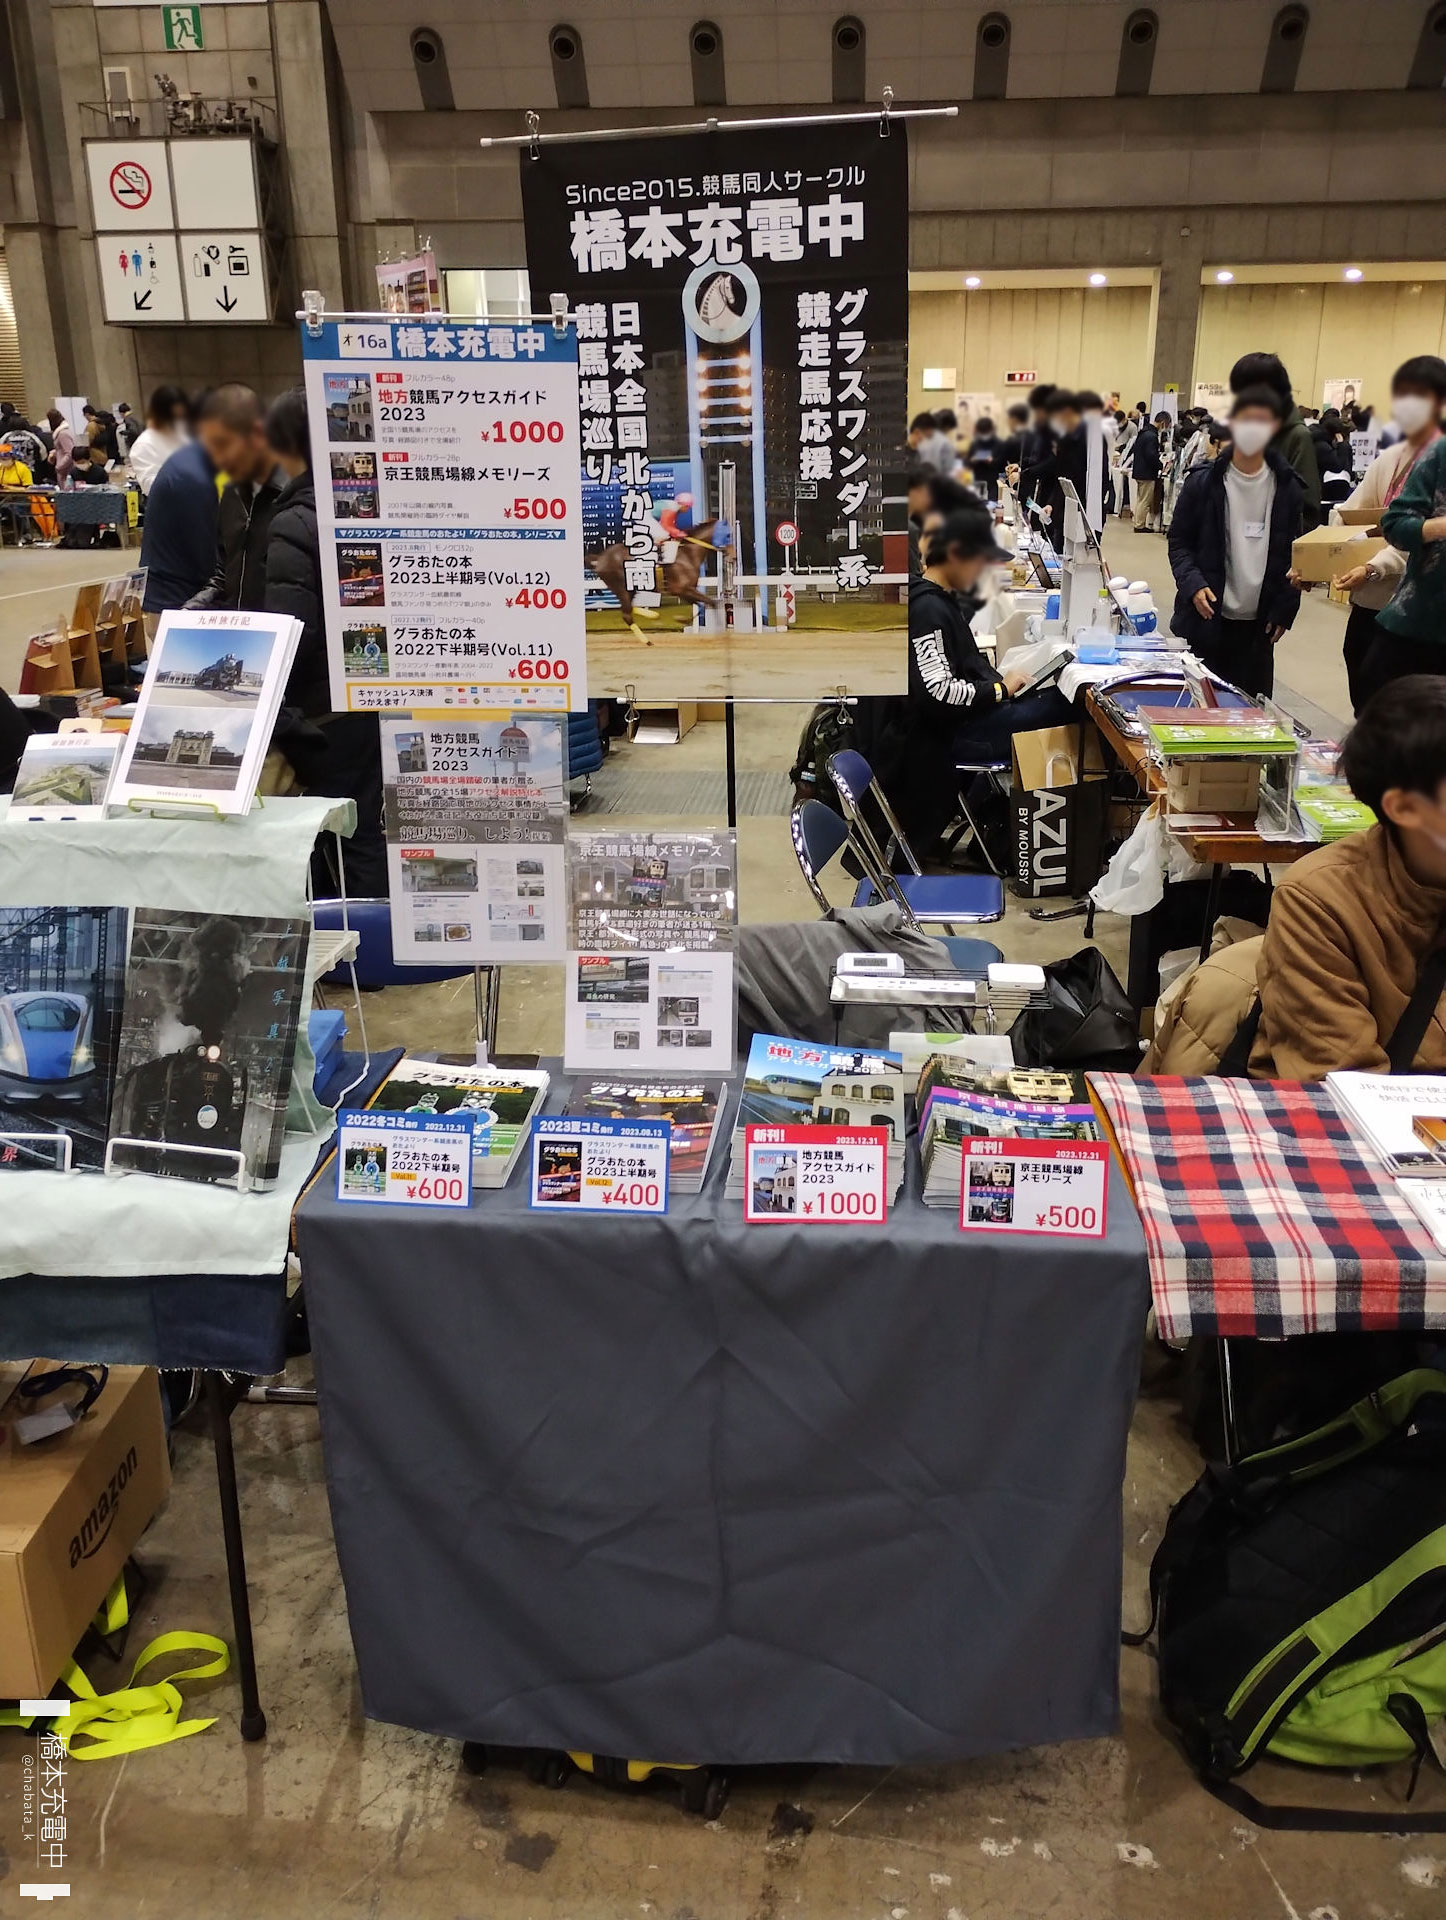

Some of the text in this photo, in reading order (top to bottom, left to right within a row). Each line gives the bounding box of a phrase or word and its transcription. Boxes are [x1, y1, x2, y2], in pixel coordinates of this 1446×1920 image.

[566, 166, 866, 204] Since2015.競馬同人サークル
[570, 194, 864, 272] 橋本充電中
[397, 327, 545, 359] 橋本充電中
[575, 303, 615, 486] 競馬場巡り
[797, 293, 834, 482] 競走馬応援
[378, 389, 547, 405] 地方競馬アクセスガイド
[380, 407, 426, 421] 2023
[480, 420, 564, 443] ¥1000
[835, 288, 872, 588] グラスワンダー系
[612, 302, 660, 591] 日本全国北から南
[384, 466, 550, 482] 京王競馬場線メモリーズ
[503, 498, 567, 520] ¥500
[780, 529, 794, 539] 1200
[389, 555, 473, 568] グラおたの本
[390, 571, 550, 585] 2023上半期号(Vol.12)
[505, 588, 566, 609] ¥400
[198, 615, 251, 626] 九州旅行記
[394, 628, 476, 640] グラおたの本
[395, 643, 553, 657] 2022下半期号(Vol.11)
[508, 660, 569, 680] ¥600
[358, 689, 434, 697] キャッシュレス決済
[431, 733, 480, 745] 地方競馬
[432, 747, 517, 758] アクセスガイド
[432, 760, 469, 771] 2023
[1018, 808, 1028, 885] BY MOUSSY
[1033, 791, 1067, 896] AZUL
[579, 845, 722, 857] 京王競馬場線メモリーズ
[591, 1086, 704, 1098] グラおたの本
[425, 1122, 465, 1131] 2022.12.31
[753, 1129, 878, 1144] 新刊! 2023.12.31
[391, 1151, 450, 1162] グラおたの本
[802, 1150, 844, 1160] 地方競馬
[970, 1141, 1099, 1160] 新刊! 2023.12.31
[391, 1161, 461, 1173] 2022下半期号
[587, 1157, 646, 1166] グラおたの本
[803, 1163, 875, 1172] アクセスガイド
[587, 1167, 657, 1178] 2023上半期号
[1020, 1163, 1084, 1175] 京王競馬場線
[802, 1175, 834, 1184] 2023
[1021, 1174, 1072, 1184] メモリーズ
[407, 1178, 463, 1200] ¥600
[602, 1184, 659, 1205] ¥400
[803, 1192, 876, 1214] ¥1000
[1036, 1205, 1096, 1229] ¥500
[69, 1446, 138, 1569] amazon
